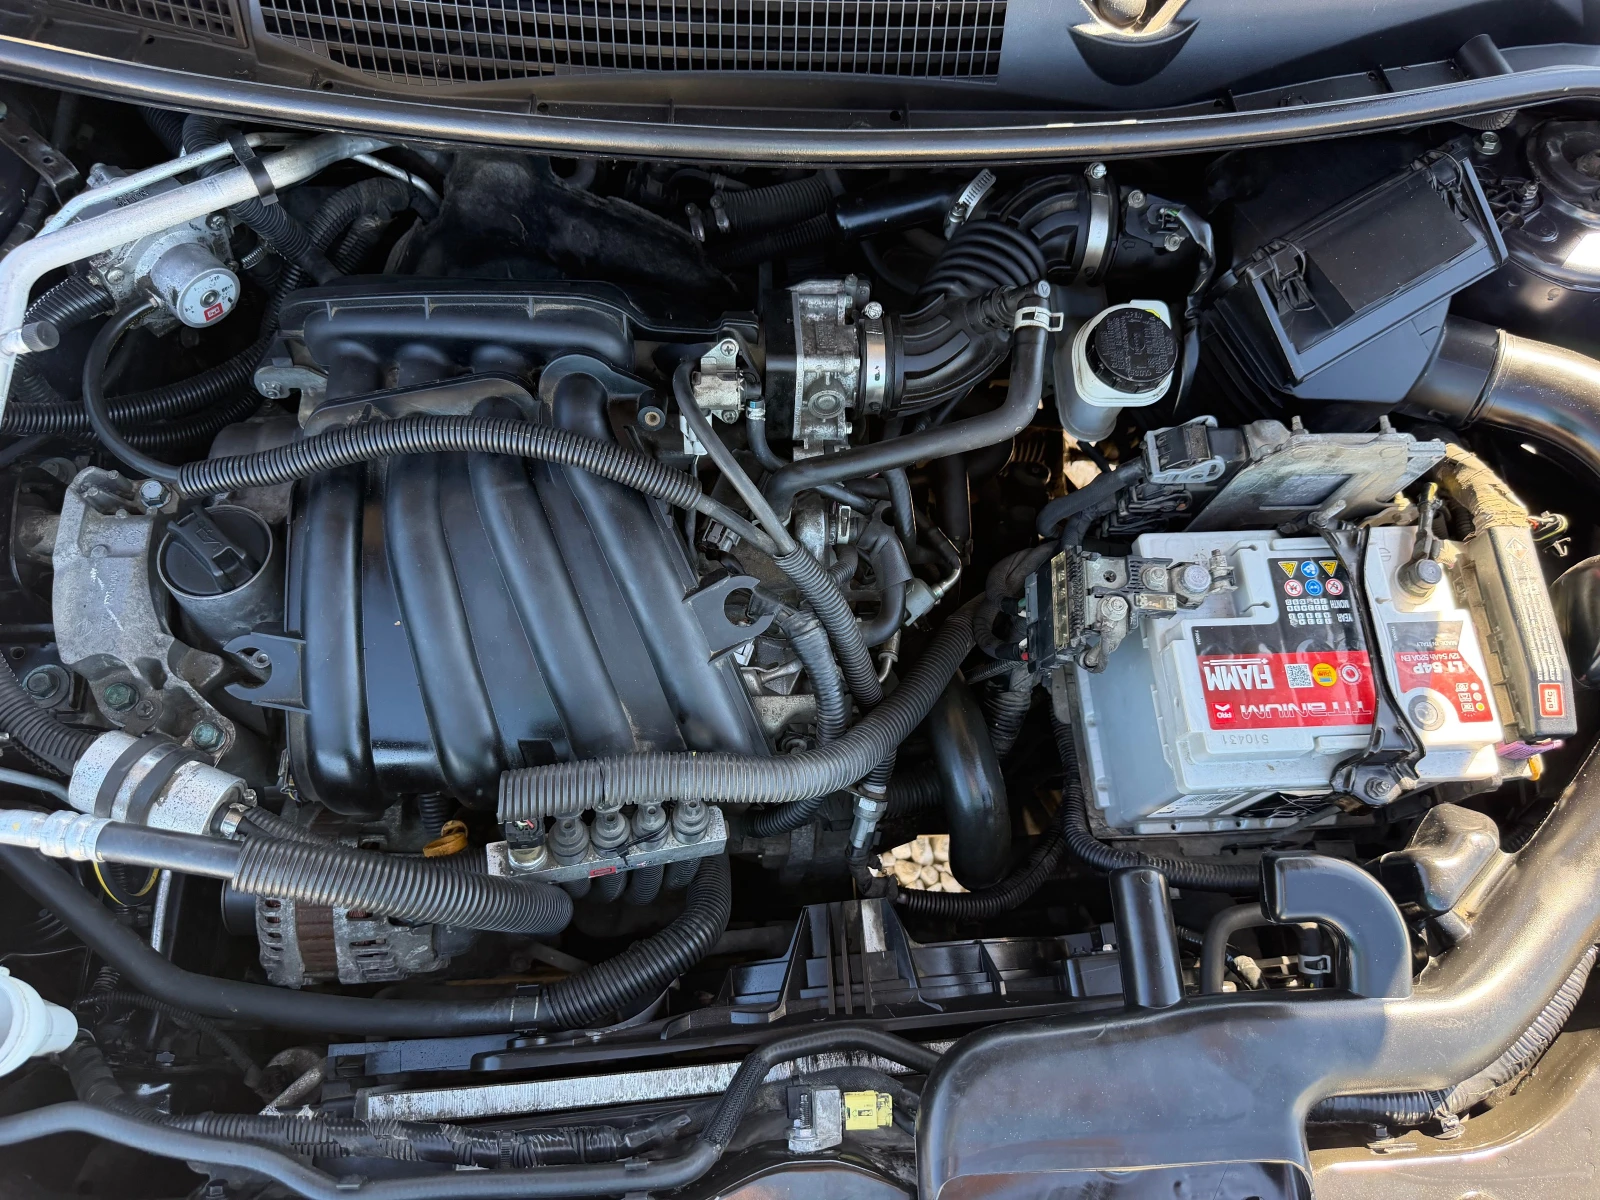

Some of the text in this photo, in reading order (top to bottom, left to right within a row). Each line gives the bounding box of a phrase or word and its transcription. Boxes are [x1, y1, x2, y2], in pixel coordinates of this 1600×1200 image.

[1330, 598, 1350, 609] MONTH
[1336, 612, 1353, 623] YEAR
[1411, 653, 1429, 661] 520A
[1429, 653, 1448, 661] 54Ah
[1447, 652, 1461, 660] 12V
[1413, 660, 1466, 674] L1 54P
[1203, 664, 1274, 691] FIAMM
[1546, 691, 1554, 709] BRC
[1216, 711, 1232, 719] PRO
[1240, 700, 1371, 719] TITANIUM
[1221, 733, 1270, 745] 510431
